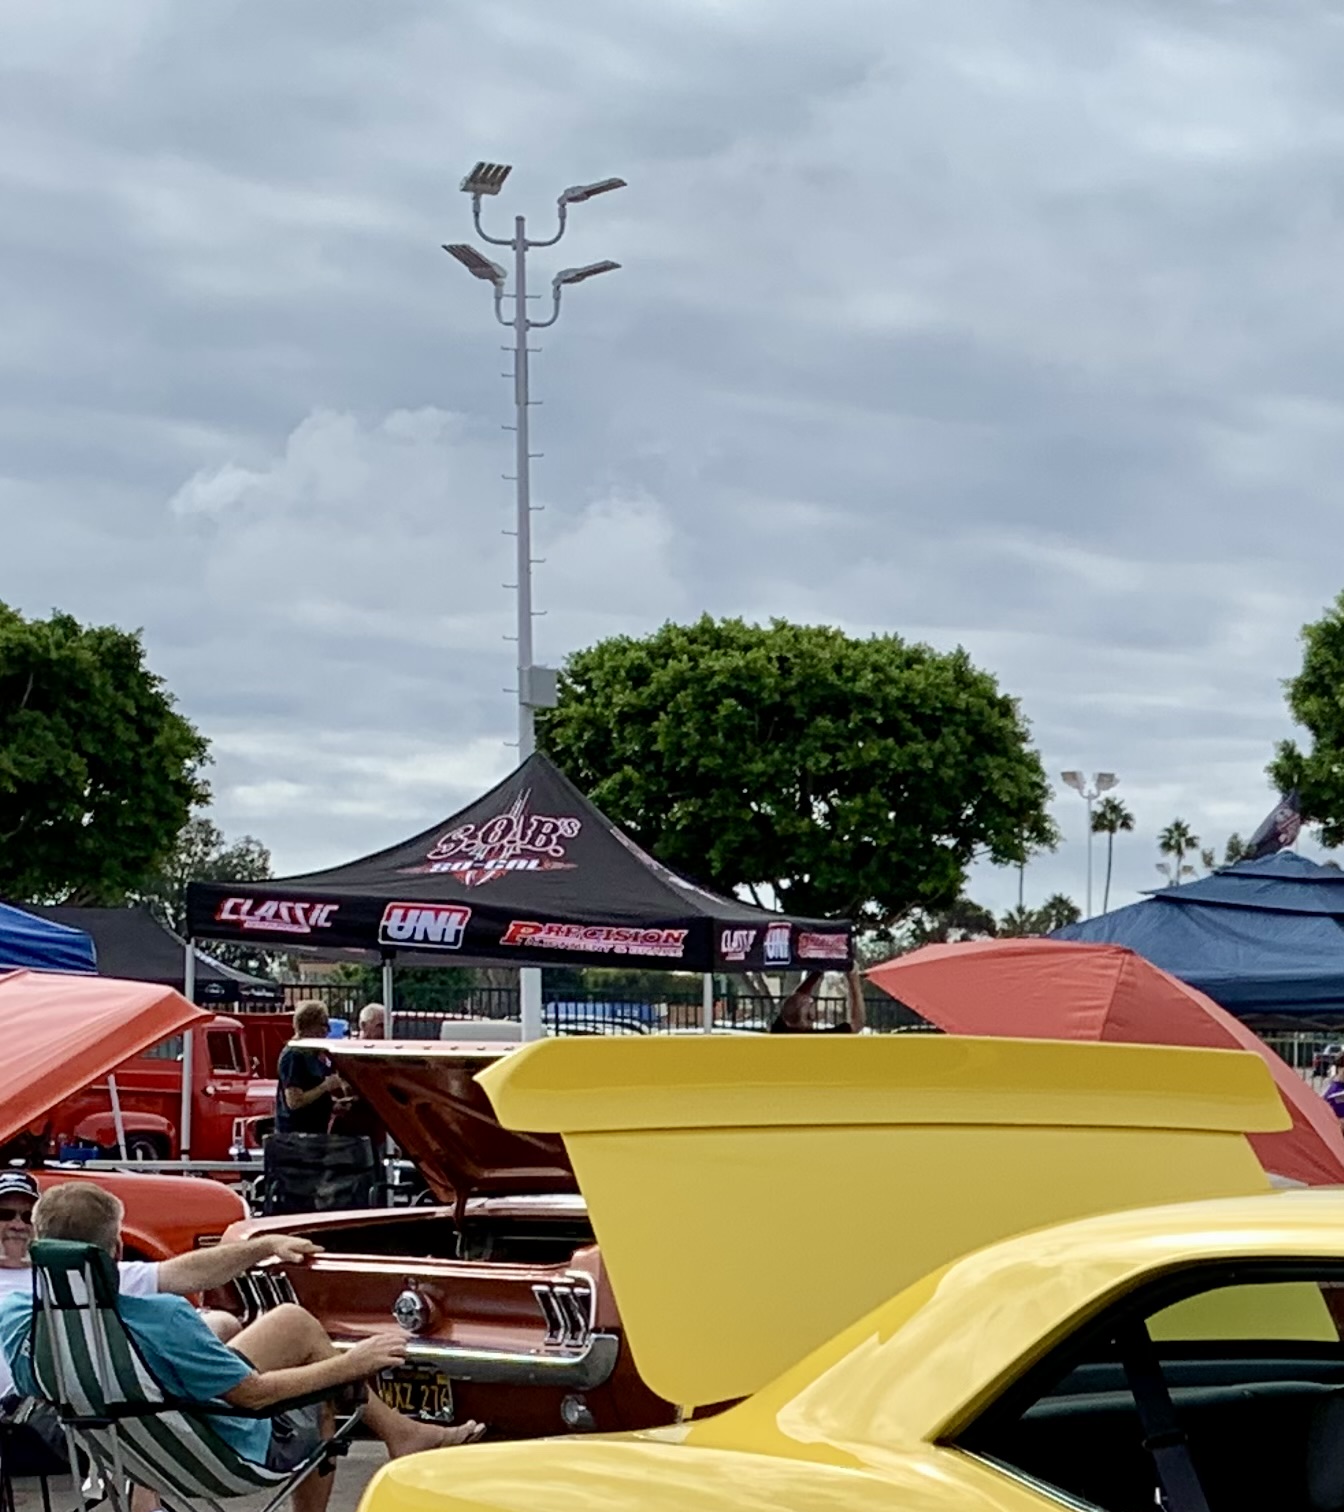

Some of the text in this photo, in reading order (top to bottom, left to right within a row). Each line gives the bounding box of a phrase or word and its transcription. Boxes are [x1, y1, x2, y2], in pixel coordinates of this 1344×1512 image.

[218, 897, 340, 929] CLASSIC
[386, 908, 466, 943] UNI
[500, 919, 689, 946] PRECISION
